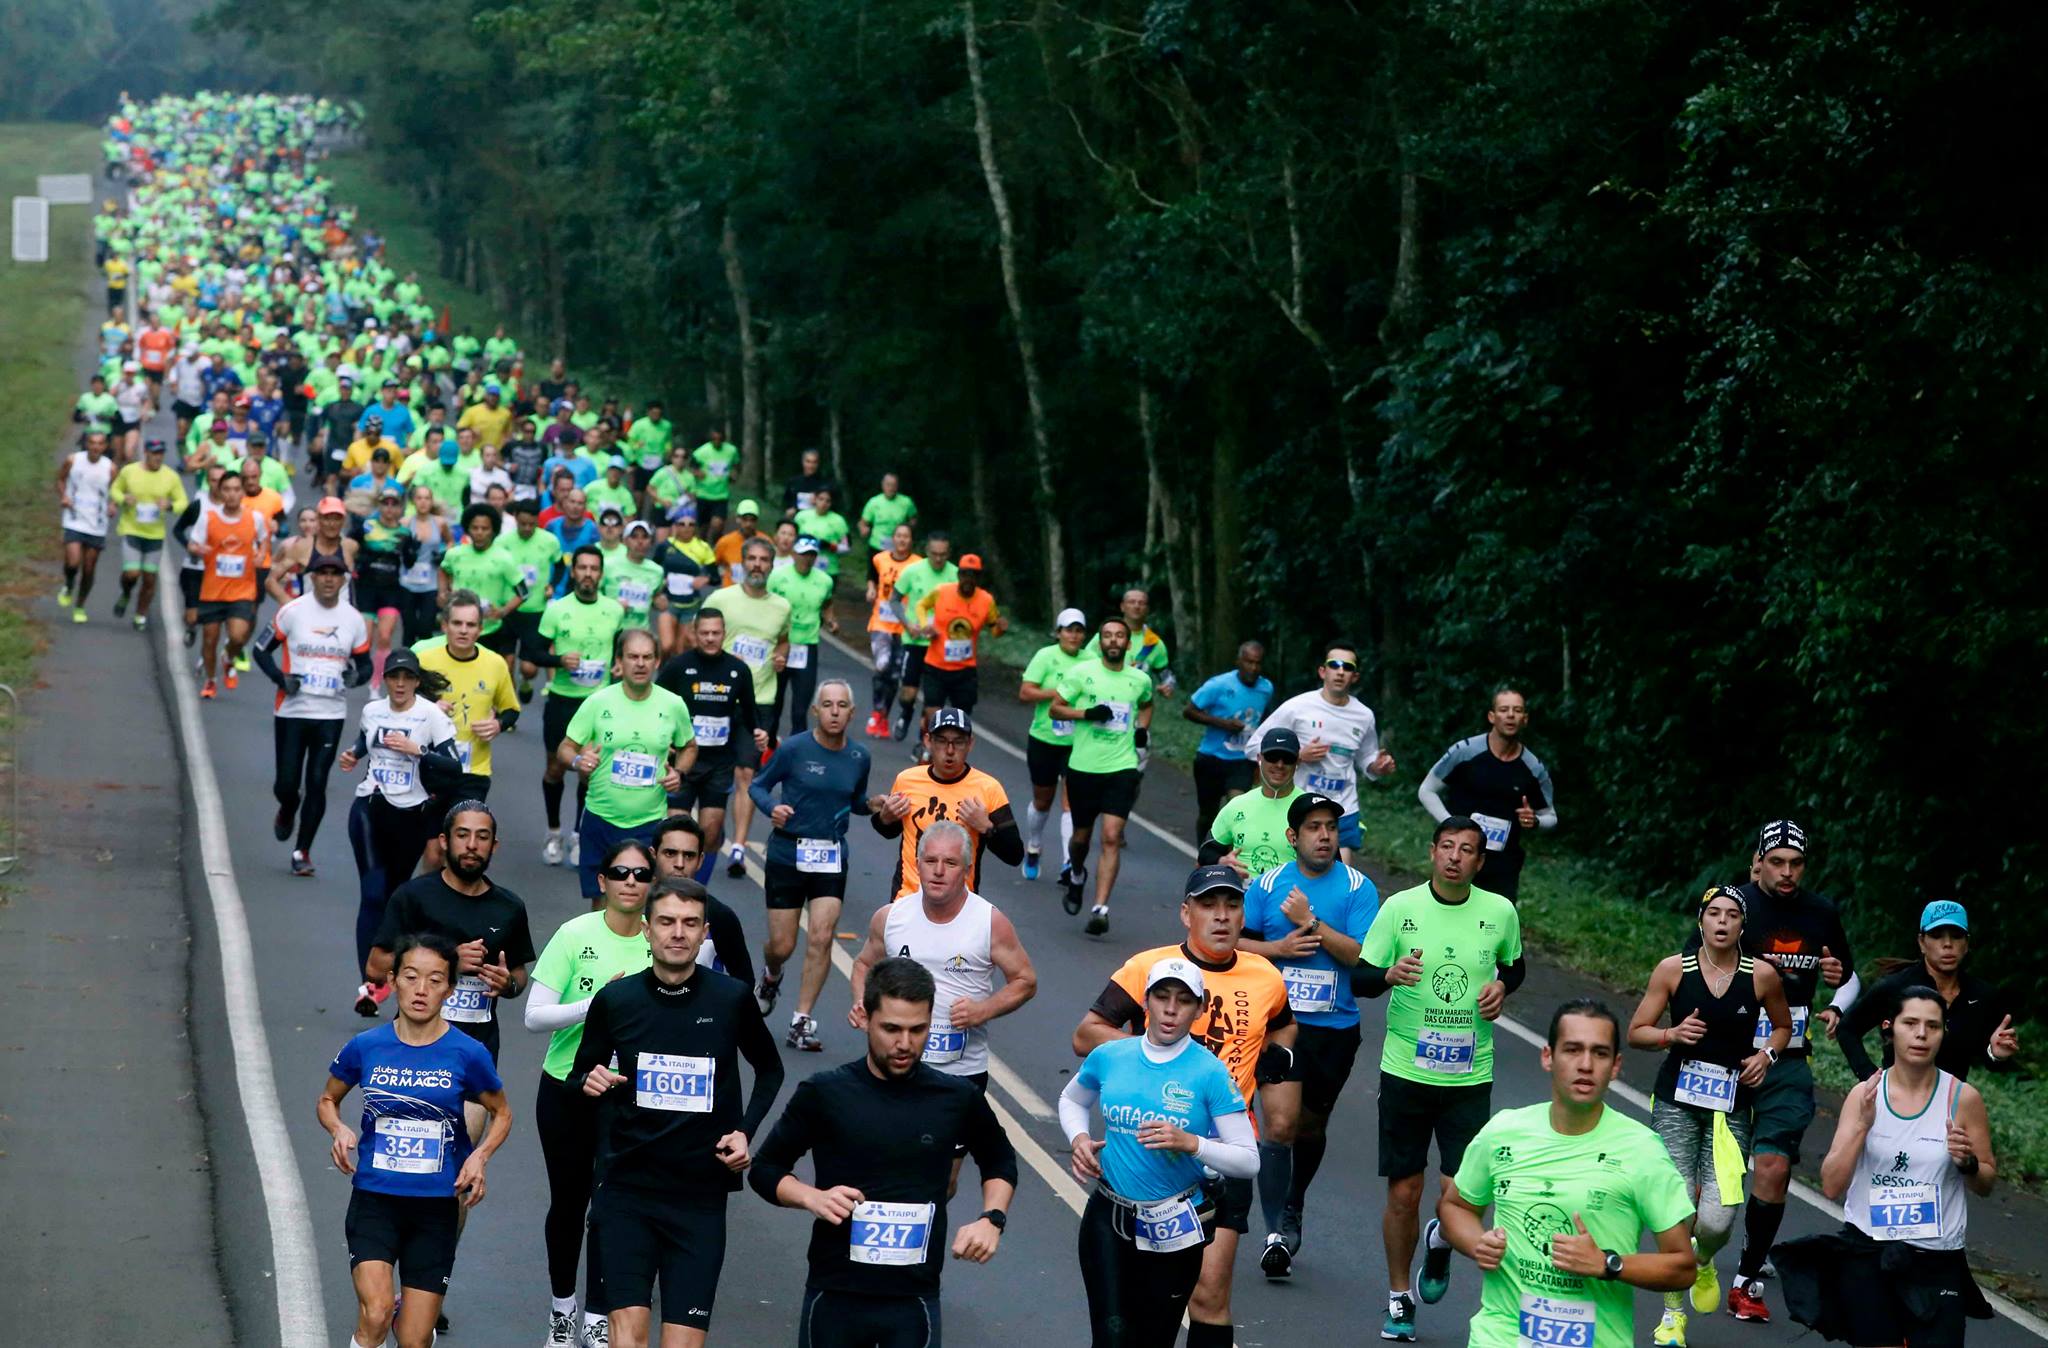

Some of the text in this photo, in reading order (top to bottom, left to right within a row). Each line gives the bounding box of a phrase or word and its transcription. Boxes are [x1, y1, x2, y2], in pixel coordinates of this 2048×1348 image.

[618, 762, 645, 777] 361
[804, 849, 829, 862] 549
[1288, 984, 1323, 999] 457
[1424, 1015, 1473, 1025] DAS CATARATAS
[1425, 1044, 1461, 1062] 615
[373, 1065, 452, 1078] clube de corrida
[669, 1061, 696, 1069] ITAIPU
[642, 1071, 697, 1095] 1601
[1682, 1073, 1726, 1098] 1214
[403, 1125, 430, 1134] ITAIPU
[385, 1136, 426, 1158] 354
[1898, 1191, 1924, 1199] ITAIPU
[888, 1210, 917, 1218] ITAIPU
[1154, 1204, 1179, 1218] ITAIPU
[1882, 1204, 1923, 1225] 175
[863, 1223, 913, 1247] 247
[1142, 1217, 1184, 1240] 162
[1519, 1268, 1535, 1281] DAS
[1535, 1272, 1584, 1289] CATARATAS
[1553, 1306, 1585, 1316] ITAIPU
[1523, 1313, 1587, 1346] 1573
